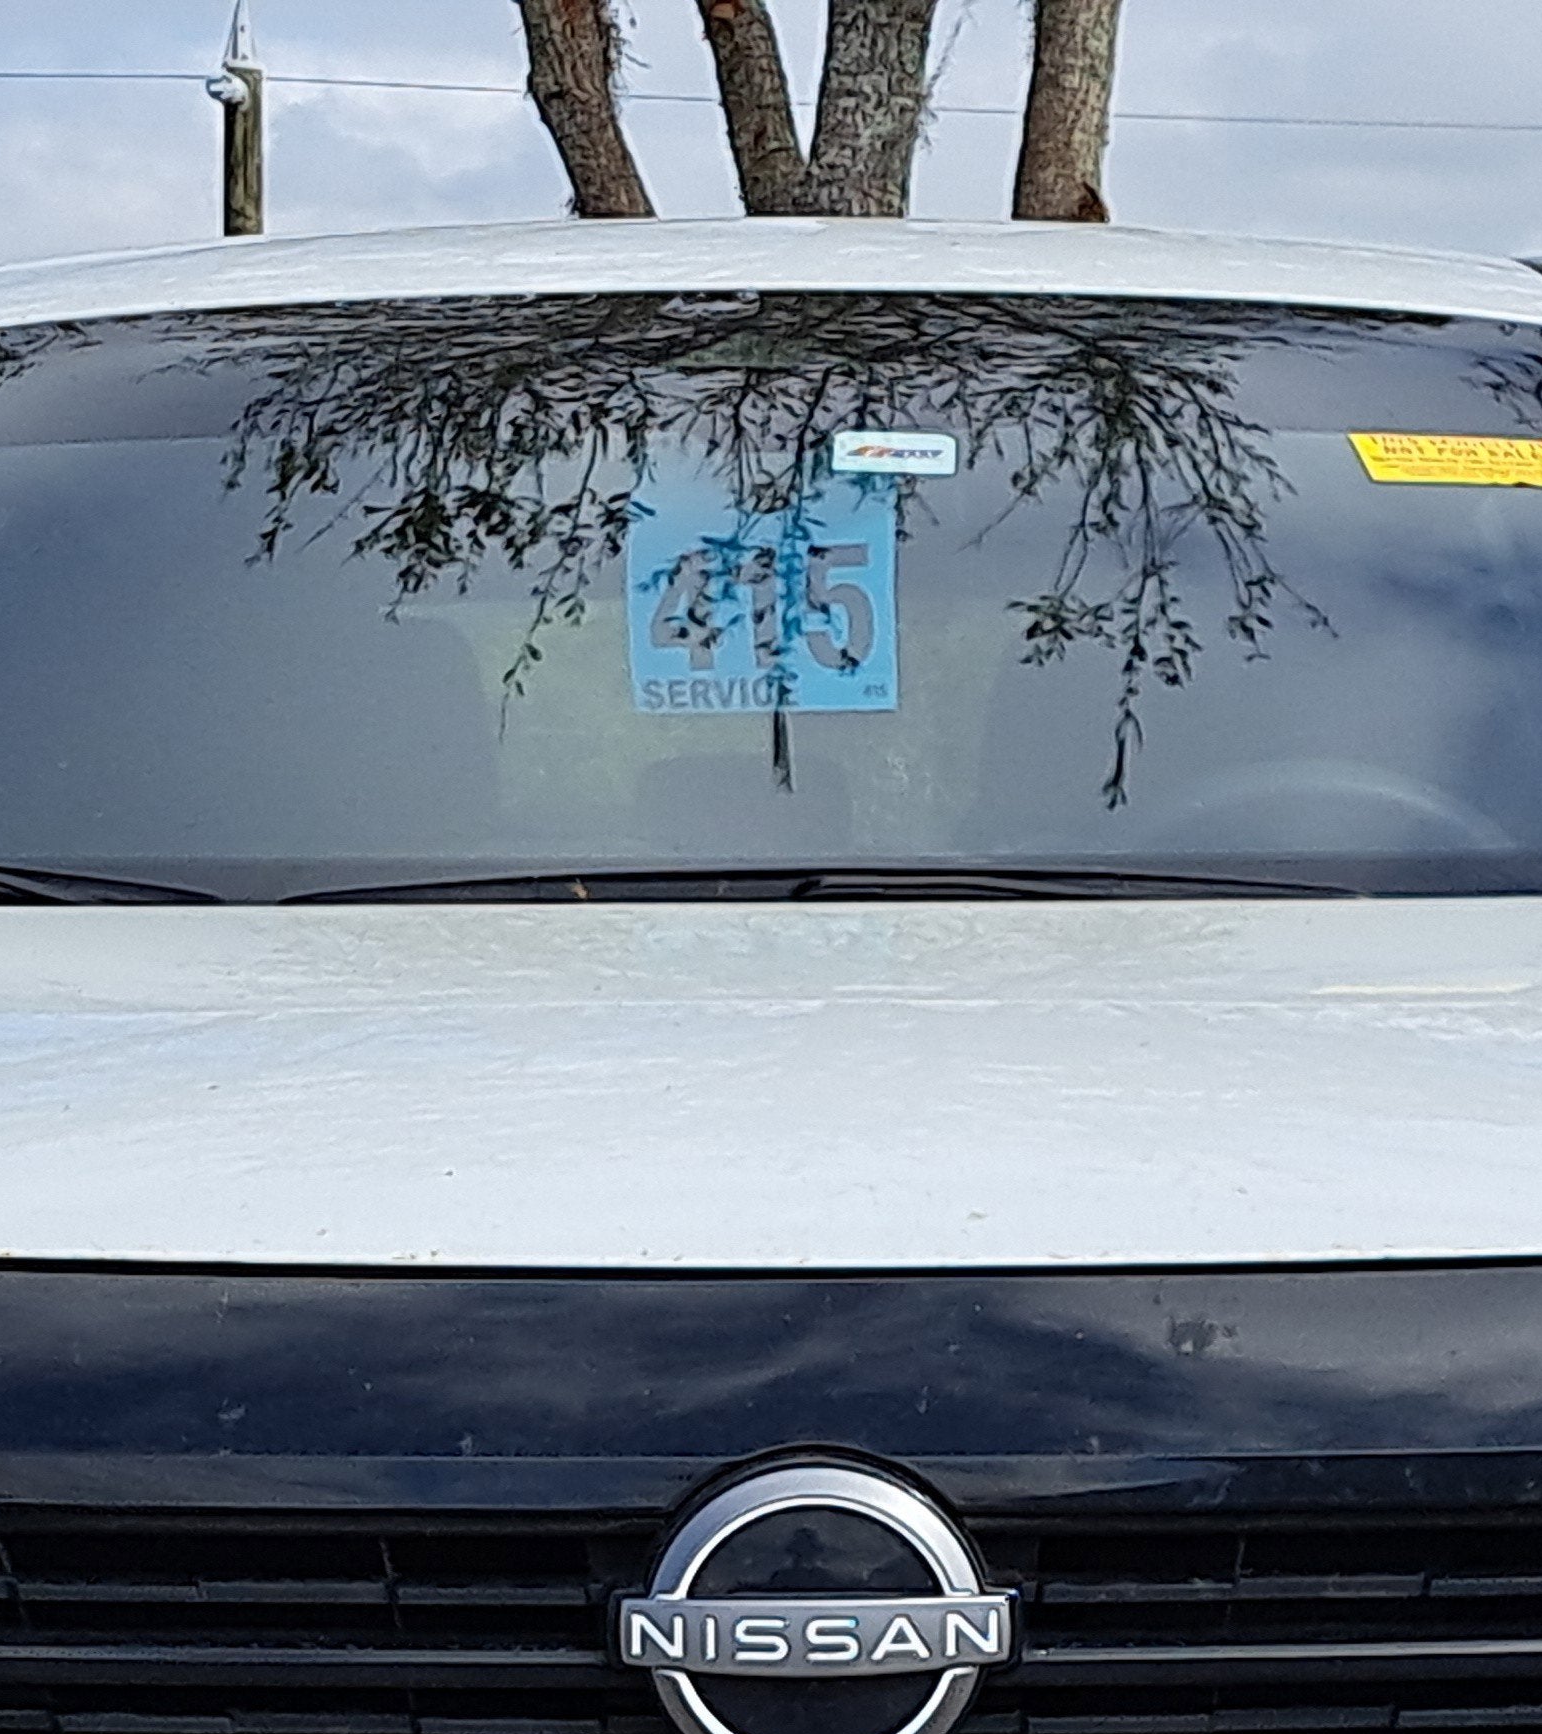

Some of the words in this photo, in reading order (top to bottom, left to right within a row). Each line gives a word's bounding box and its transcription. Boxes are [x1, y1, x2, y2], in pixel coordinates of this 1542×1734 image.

[650, 543, 875, 672] 415
[642, 676, 800, 709] SERVICE
[628, 1608, 1000, 1663] NISSAN
